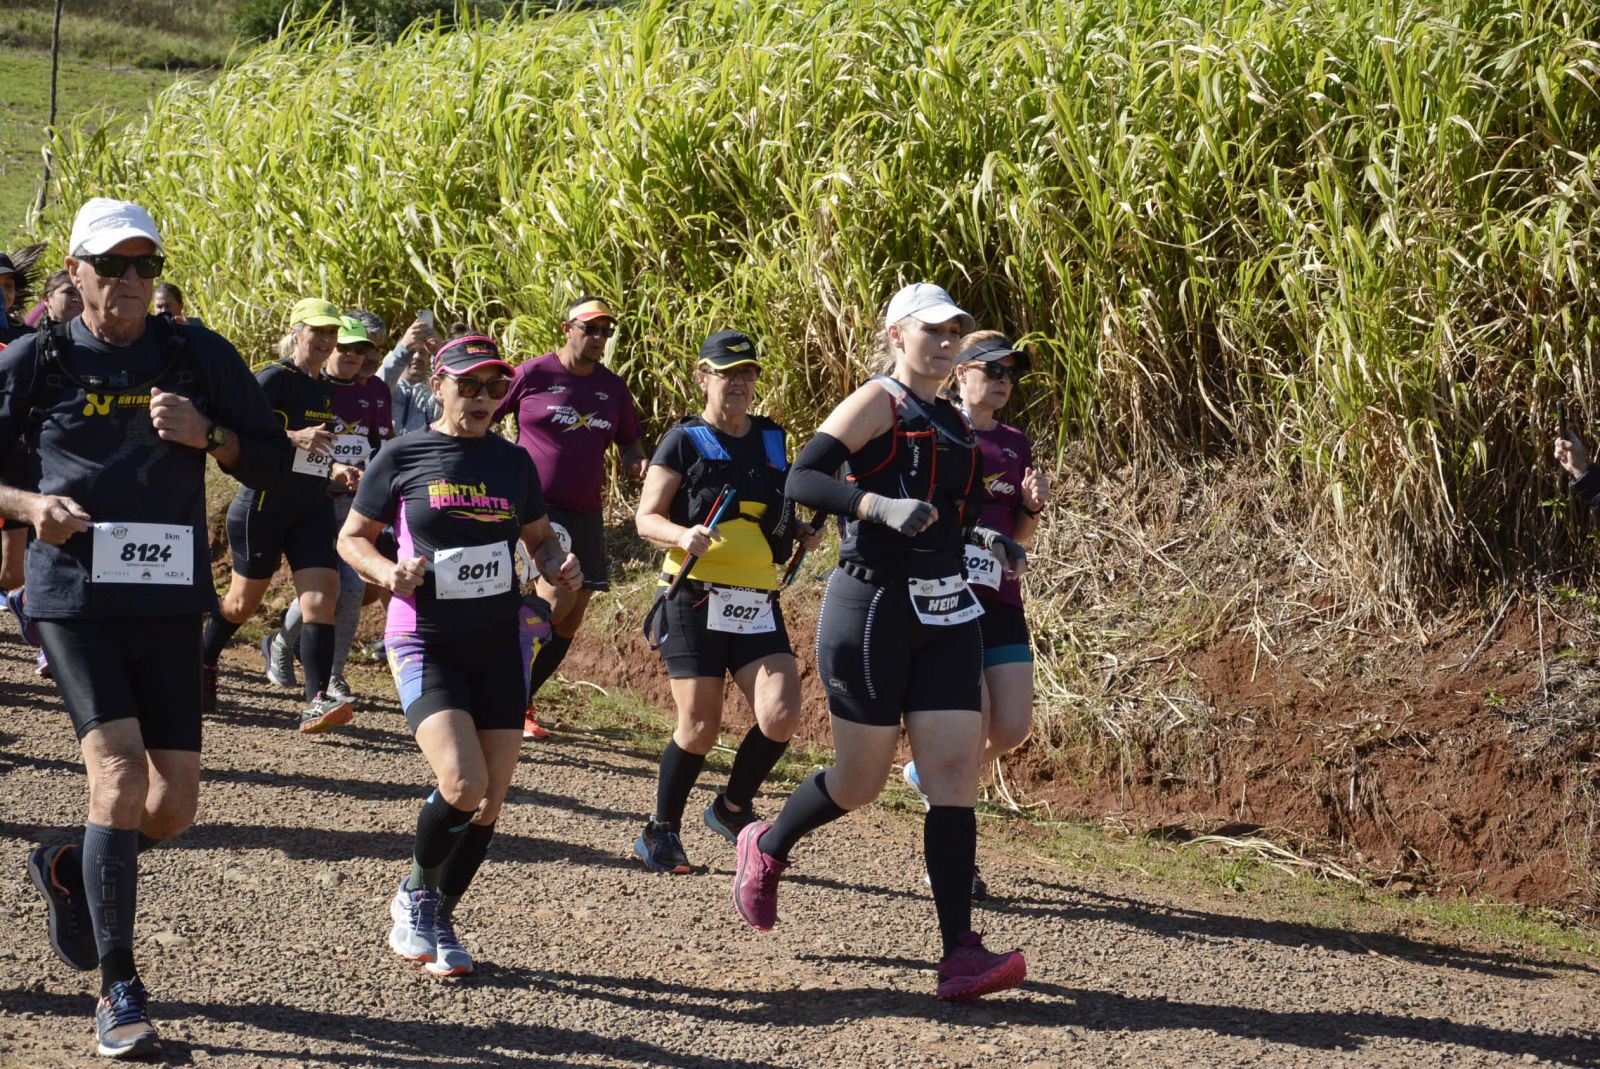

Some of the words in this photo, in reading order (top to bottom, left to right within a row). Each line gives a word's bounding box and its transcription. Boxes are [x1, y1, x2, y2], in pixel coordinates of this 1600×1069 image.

[334, 445, 363, 456] 8019
[306, 453, 328, 466] 803
[429, 494, 510, 510] GOULARTE
[164, 532, 180, 541] 8km
[120, 542, 172, 562] 8124
[457, 560, 500, 581] 8011
[928, 595, 960, 612] HEIDI
[722, 604, 760, 620] 8027
